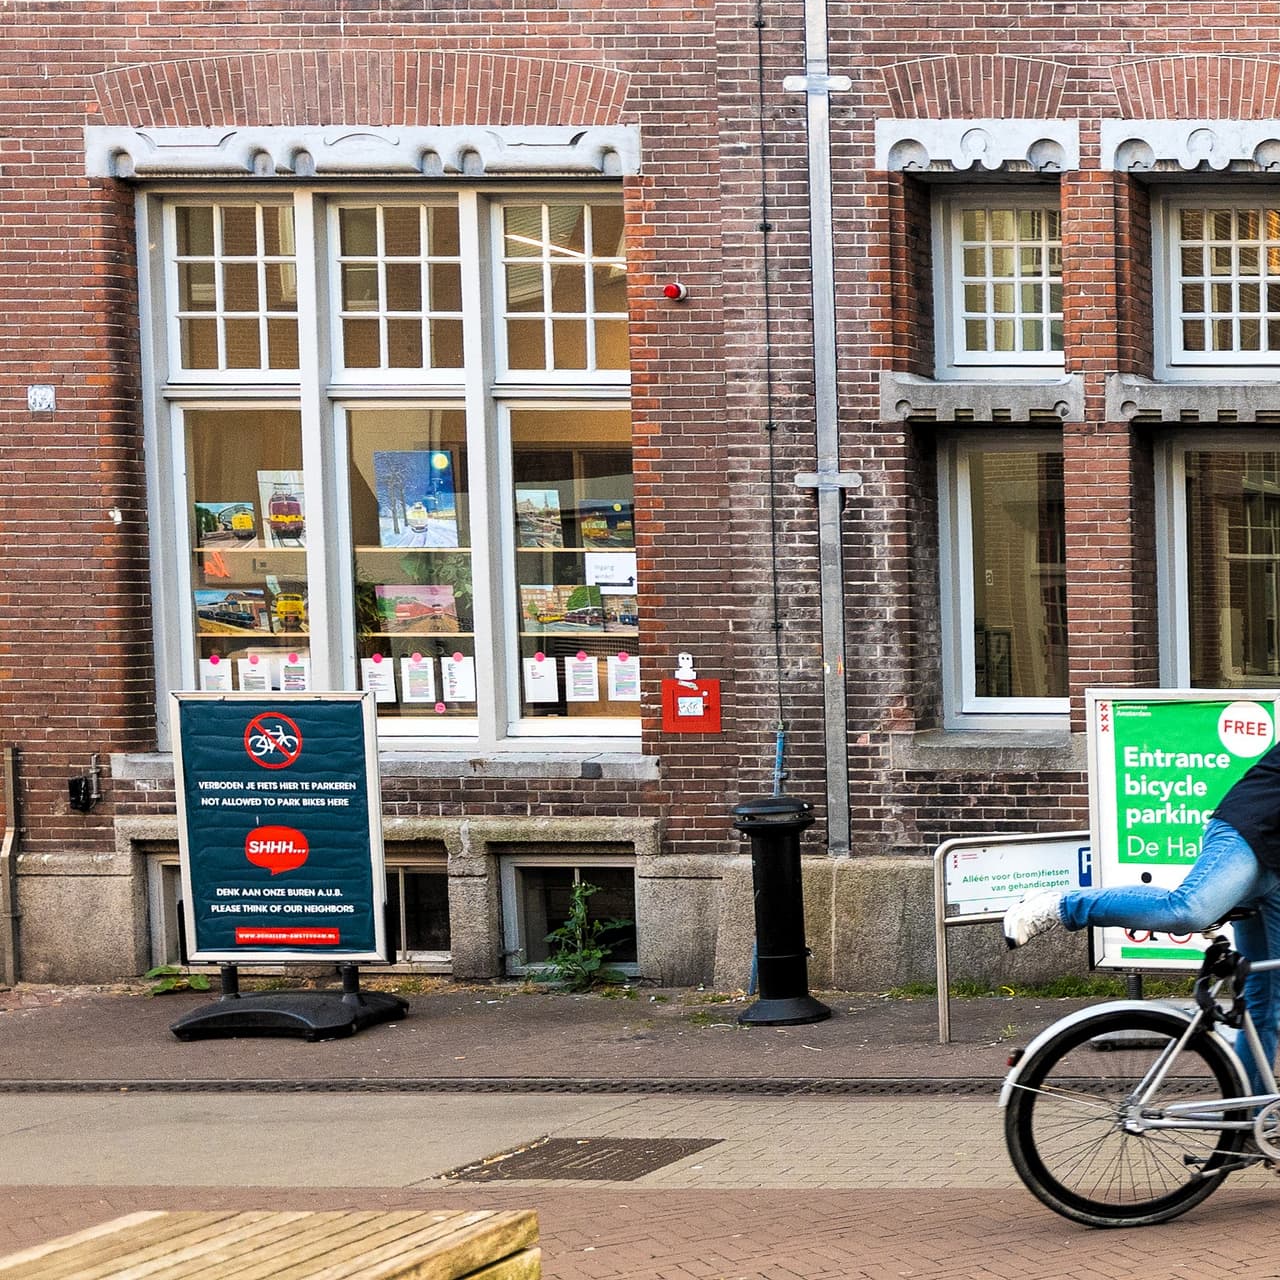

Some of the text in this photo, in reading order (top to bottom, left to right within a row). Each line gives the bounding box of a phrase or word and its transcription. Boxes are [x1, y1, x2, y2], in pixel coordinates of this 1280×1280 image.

[1223, 719, 1267, 736] FREE
[1123, 746, 1231, 768] Entrance
[198, 781, 356, 790] VERBODEN JE FIETS HIER TE PARKEREN
[1124, 773, 1208, 801] bicycle
[201, 798, 349, 806] NOT ALLOWED TO PARK BIKES HERE
[248, 840, 306, 854] SHHH...
[1127, 835, 1159, 857] De
[991, 872, 1011, 881] voor
[1013, 868, 1070, 880] (brom)fietsen
[991, 879, 1070, 892] van gehandicapten
[216, 888, 343, 897] DENK AAN ONZE BUREN A.U.B.
[211, 904, 355, 913] PLEASE THINK OF OUR NEIGHBORS
